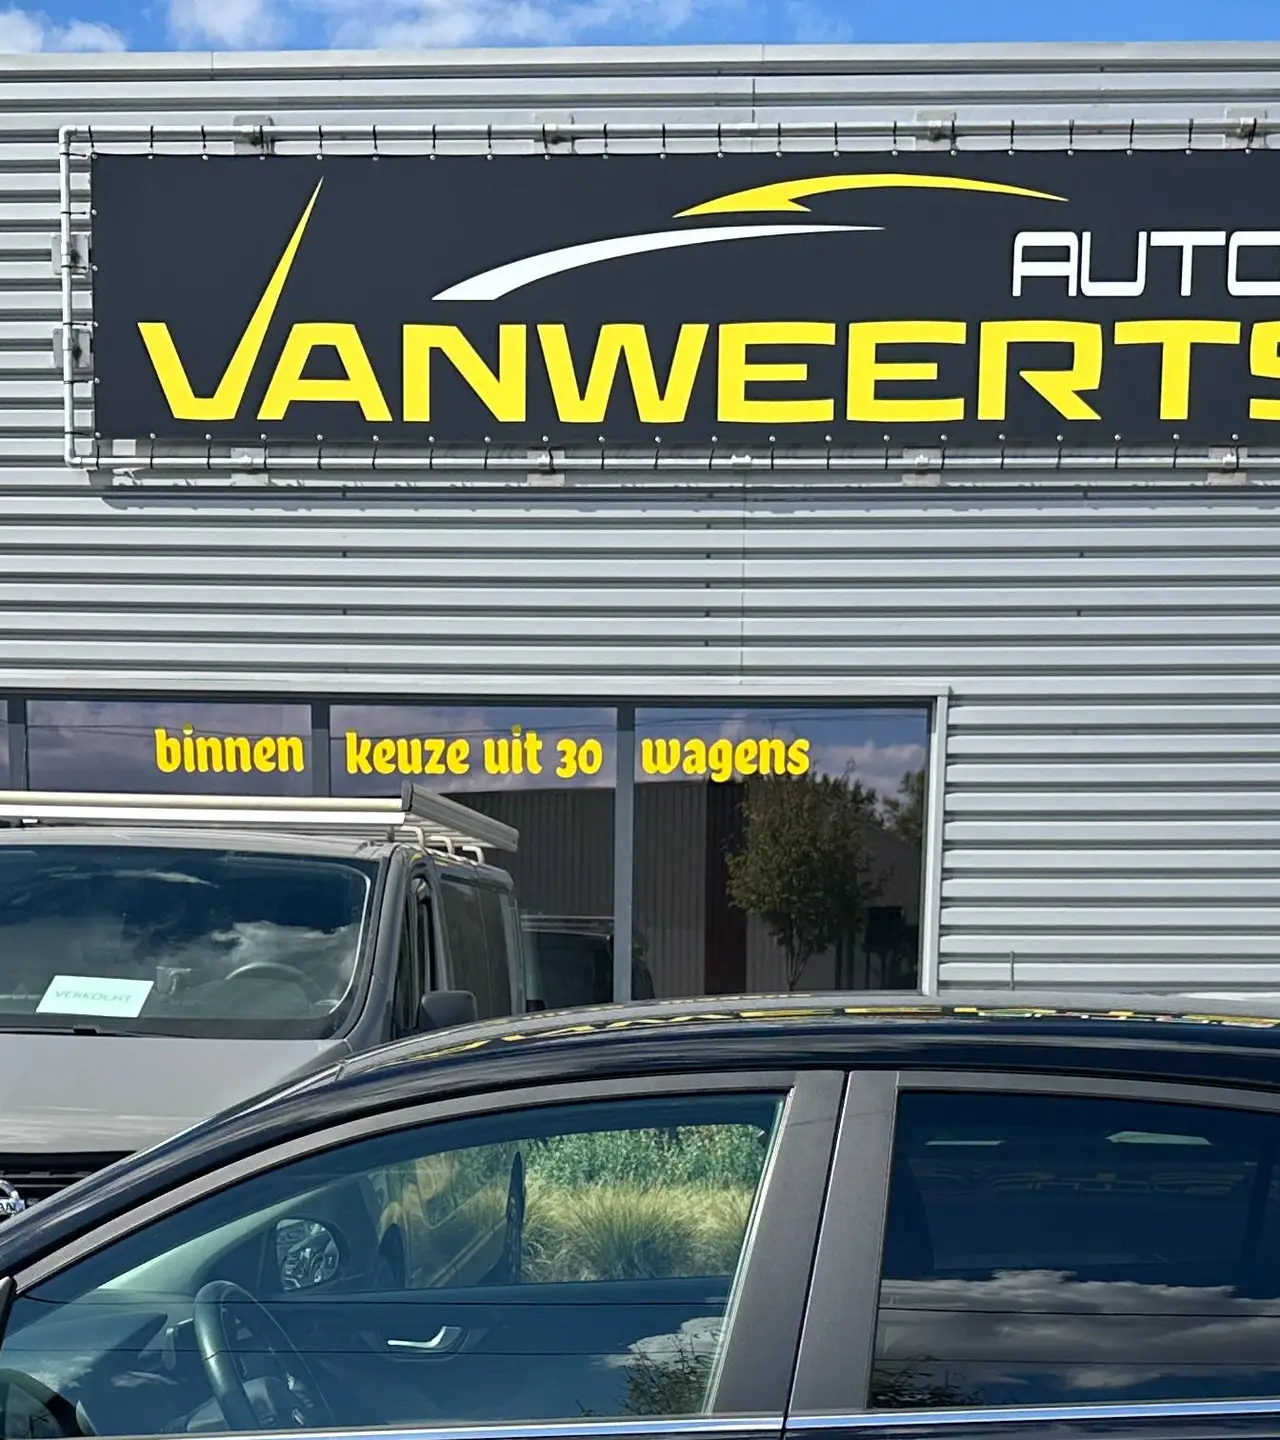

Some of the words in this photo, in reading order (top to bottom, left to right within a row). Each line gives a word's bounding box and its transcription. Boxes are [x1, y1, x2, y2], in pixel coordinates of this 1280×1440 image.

[154, 724, 305, 774] binnen
[345, 731, 470, 775] keuze
[483, 724, 542, 776] uit
[556, 738, 604, 779] 30
[641, 738, 811, 783] wagens
